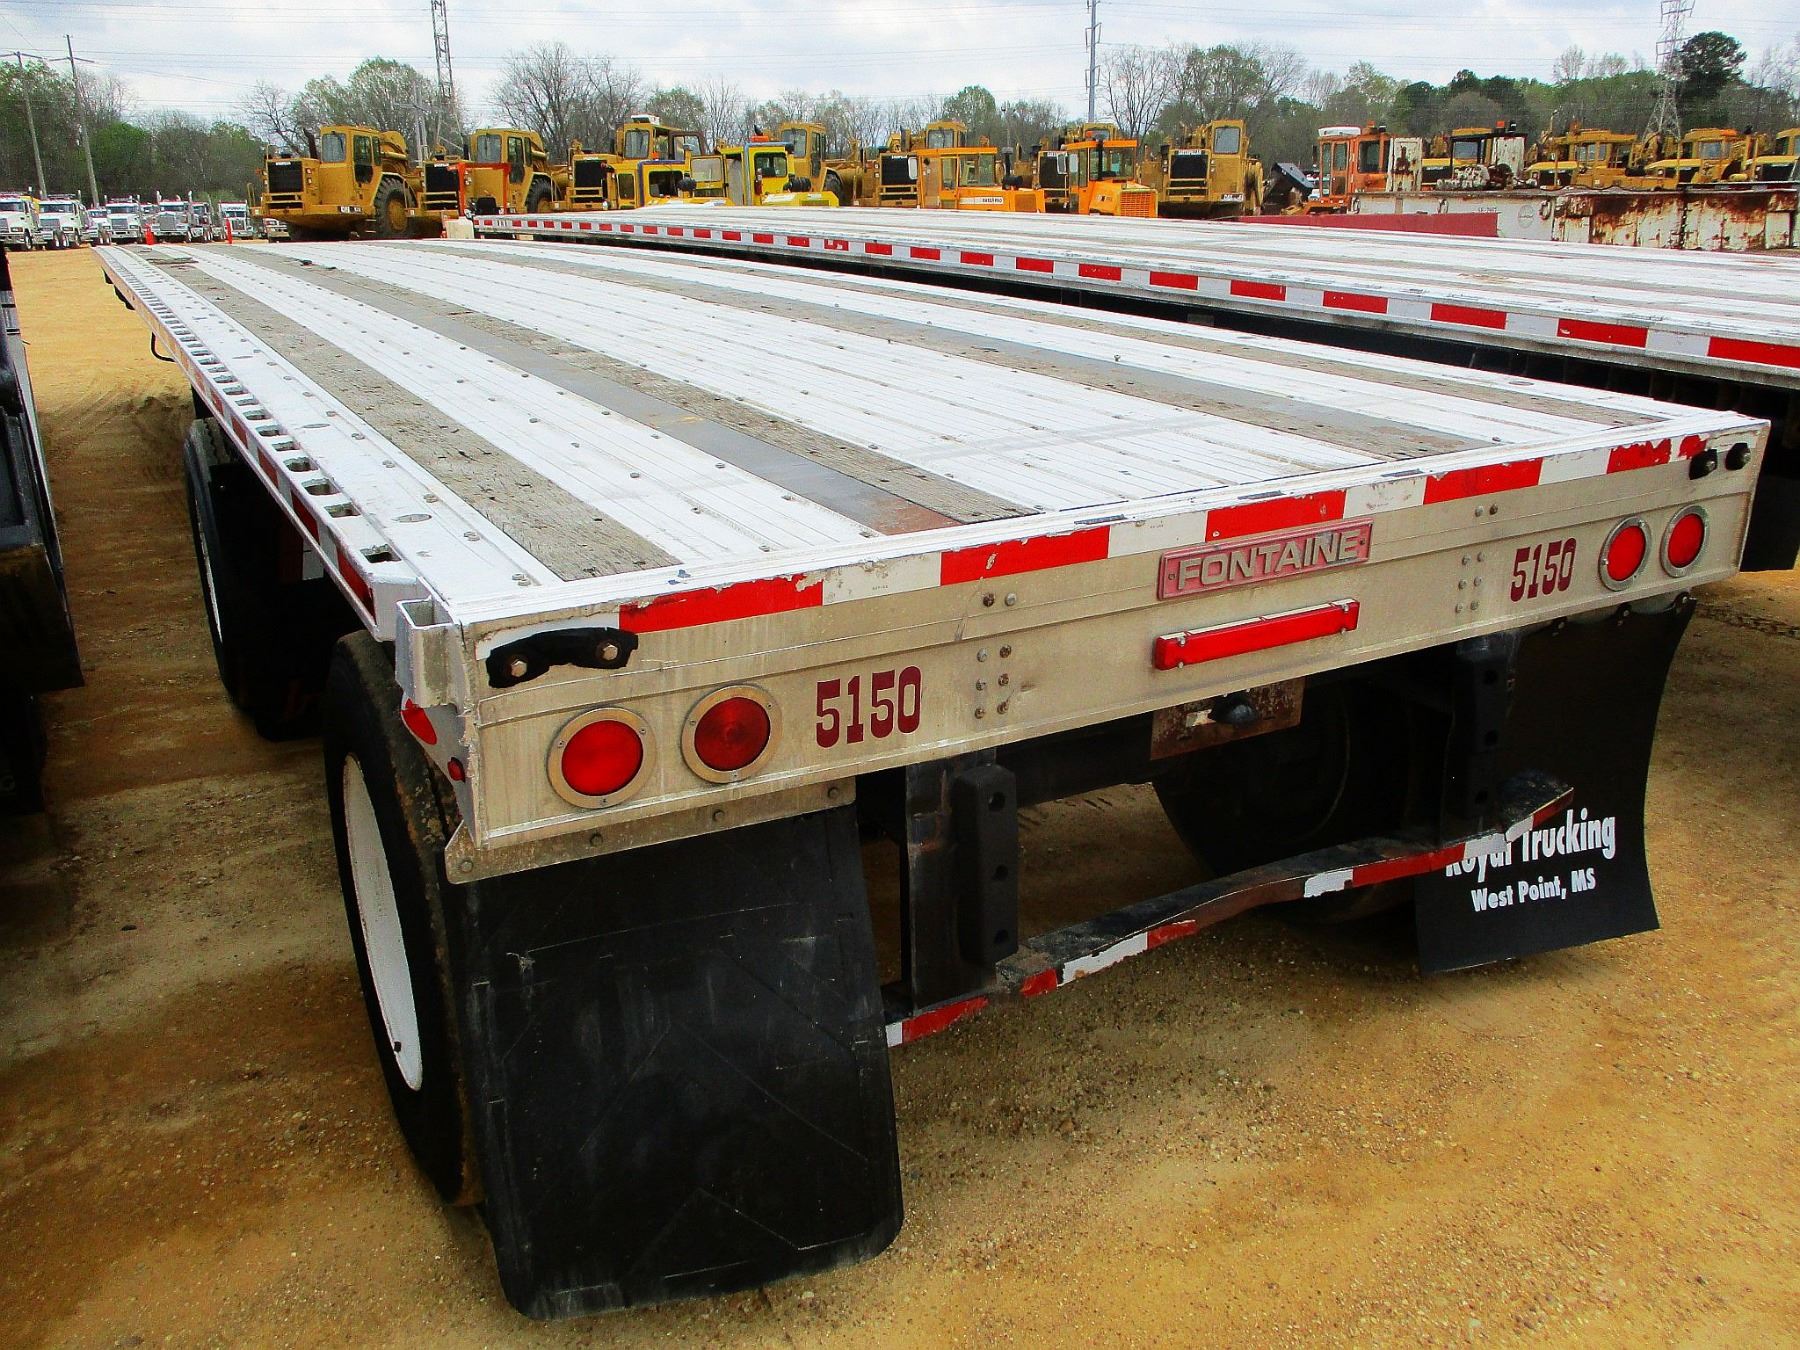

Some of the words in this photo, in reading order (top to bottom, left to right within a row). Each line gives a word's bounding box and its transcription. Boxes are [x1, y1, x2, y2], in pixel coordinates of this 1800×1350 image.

[1177, 528, 1362, 591] FONTAINE
[1510, 537, 1577, 602] 5150
[815, 665, 922, 749] 5150
[1521, 807, 1617, 860] Trucking
[1471, 885, 1514, 913] West
[1518, 875, 1567, 903] Point,
[1571, 867, 1596, 893] MS
